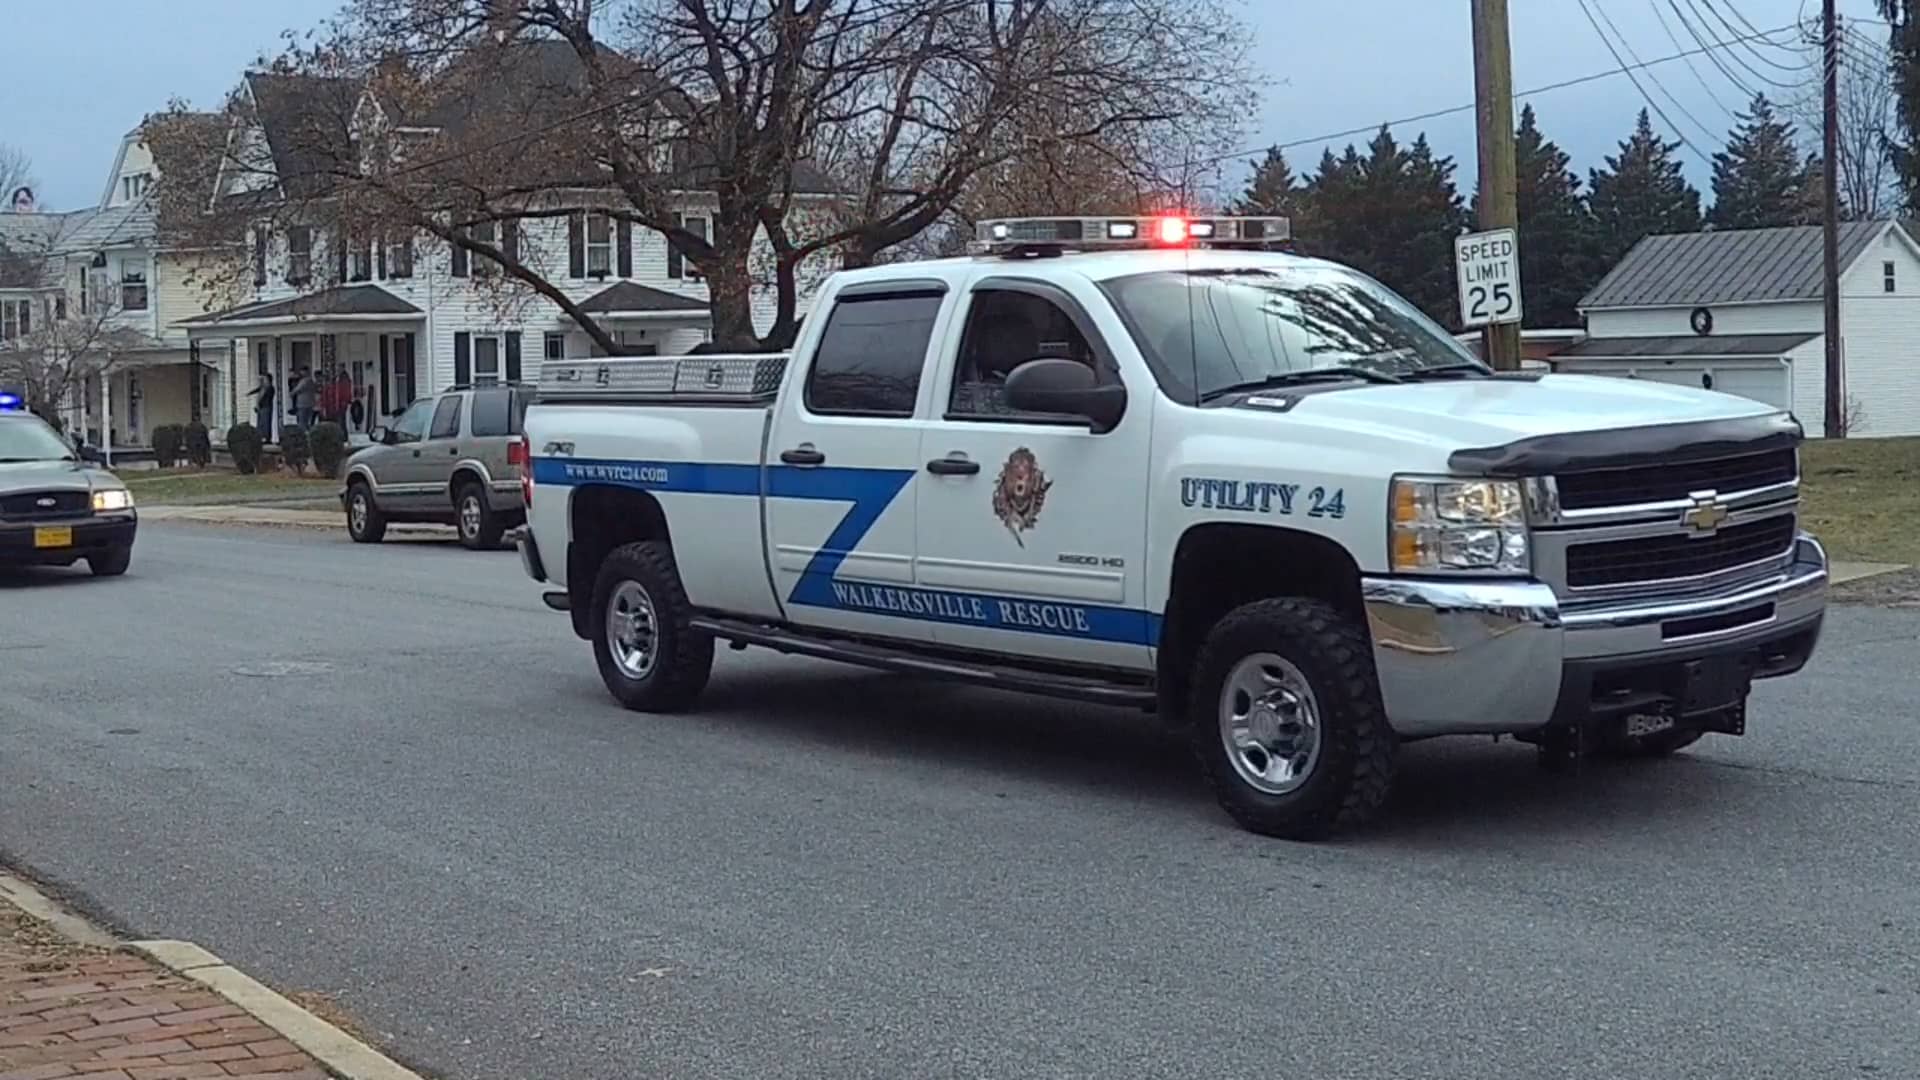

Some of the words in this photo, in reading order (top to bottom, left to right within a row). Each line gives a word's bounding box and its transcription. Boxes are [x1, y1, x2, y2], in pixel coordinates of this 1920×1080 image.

[1460, 240, 1512, 262] SPEED
[1466, 261, 1508, 282] LIMIT
[1469, 283, 1513, 318] 25
[1180, 477, 1299, 515] UTILITY
[1307, 486, 1346, 519] 24
[831, 581, 987, 621] WALKERSVILLE
[998, 600, 1090, 632] RESCUE
